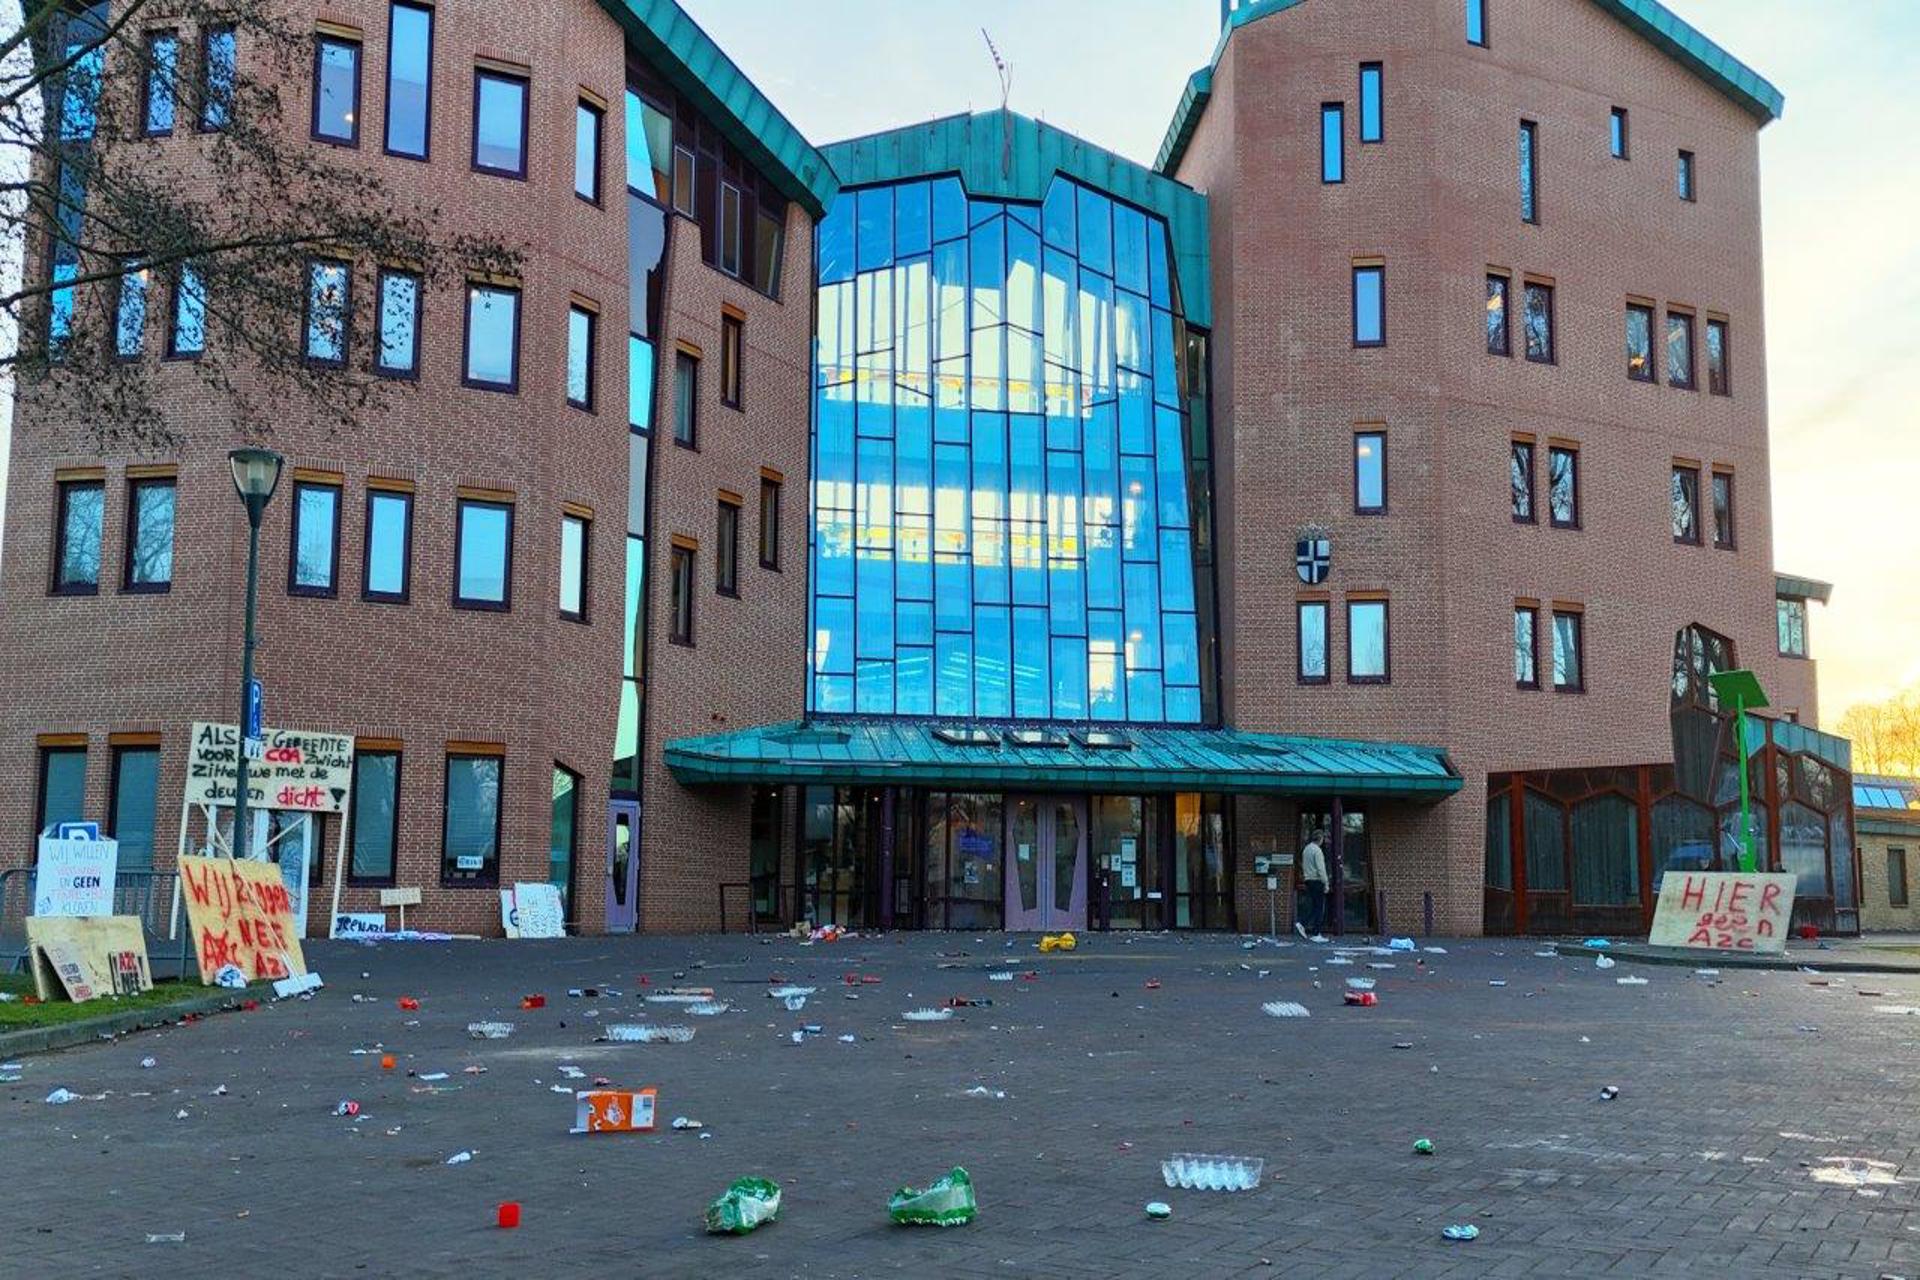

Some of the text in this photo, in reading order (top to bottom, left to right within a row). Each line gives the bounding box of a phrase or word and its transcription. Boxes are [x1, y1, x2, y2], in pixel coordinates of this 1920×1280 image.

[199, 725, 237, 746] ALS
[265, 748, 301, 764] COA
[275, 766, 305, 779] met
[310, 766, 329, 779] de
[204, 781, 265, 800] deuen
[73, 875, 101, 888] GEEN
[185, 864, 231, 919] WIJ
[1681, 876, 1781, 915] HIER
